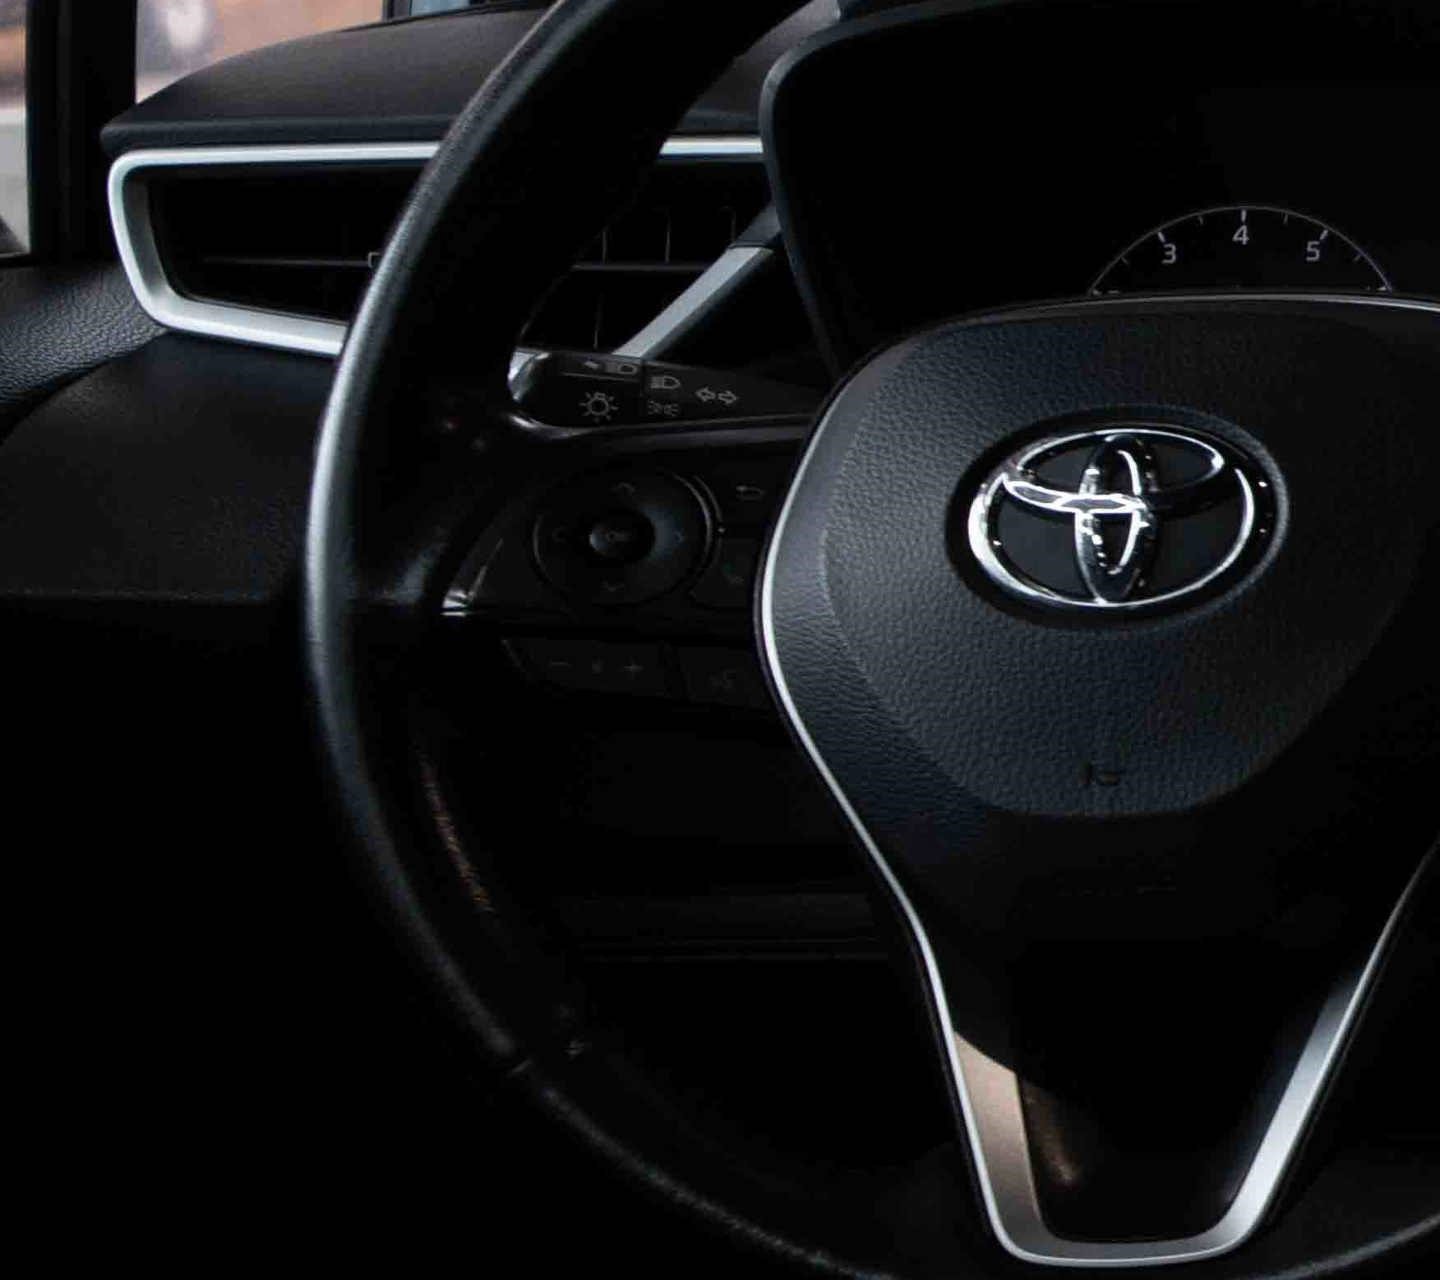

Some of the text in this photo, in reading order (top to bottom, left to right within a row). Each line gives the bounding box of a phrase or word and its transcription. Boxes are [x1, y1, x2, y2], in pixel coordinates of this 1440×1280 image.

[1231, 224, 1250, 246] 4
[1161, 242, 1177, 265] 3
[1303, 240, 1321, 263] 5
